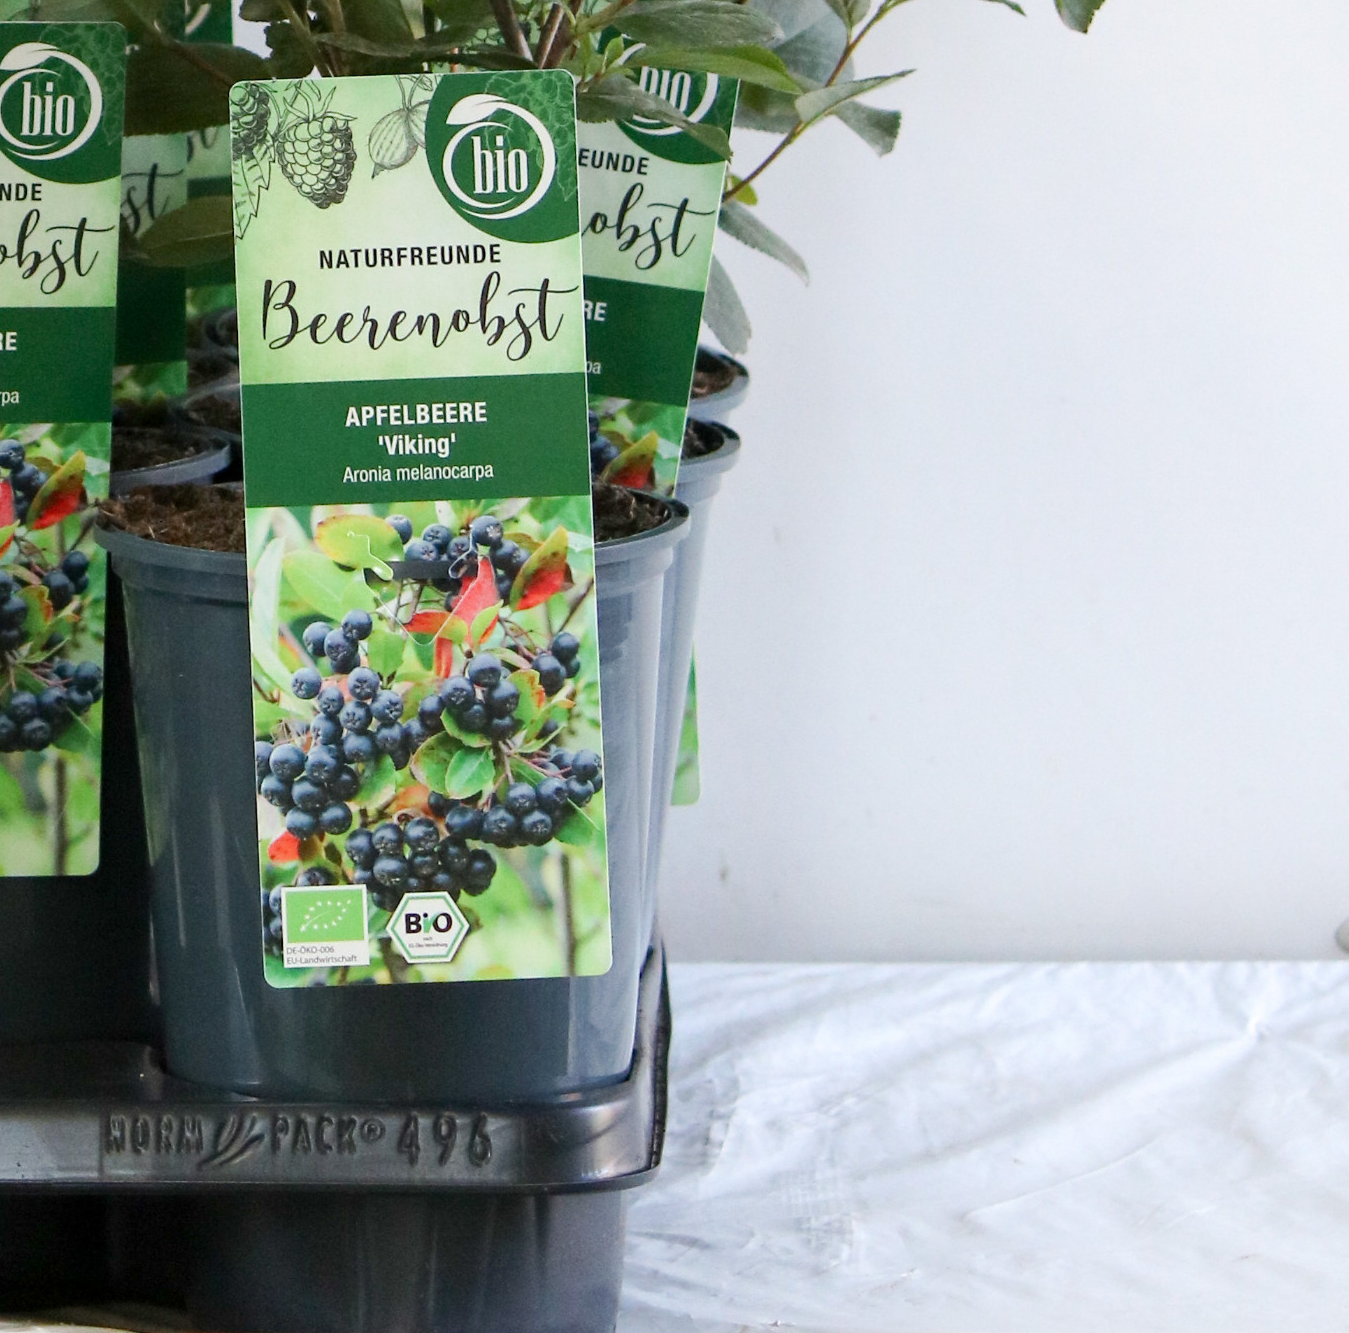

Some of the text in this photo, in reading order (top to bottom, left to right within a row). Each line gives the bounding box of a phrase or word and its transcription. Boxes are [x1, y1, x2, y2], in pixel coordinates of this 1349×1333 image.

[20, 81, 76, 137] bio
[472, 135, 529, 195] bio
[319, 243, 502, 270] NATURFREUNDE
[262, 270, 579, 362] Beerenobst
[344, 401, 488, 428] APFELBEERE
[378, 432, 457, 458] 'Viking'
[342, 461, 494, 484] Aronia melanocarpa
[286, 945, 335, 955] DE-ÖKO-006
[286, 955, 357, 965] EU-Landwirtschaft
[396, 1111, 494, 1167] 496
